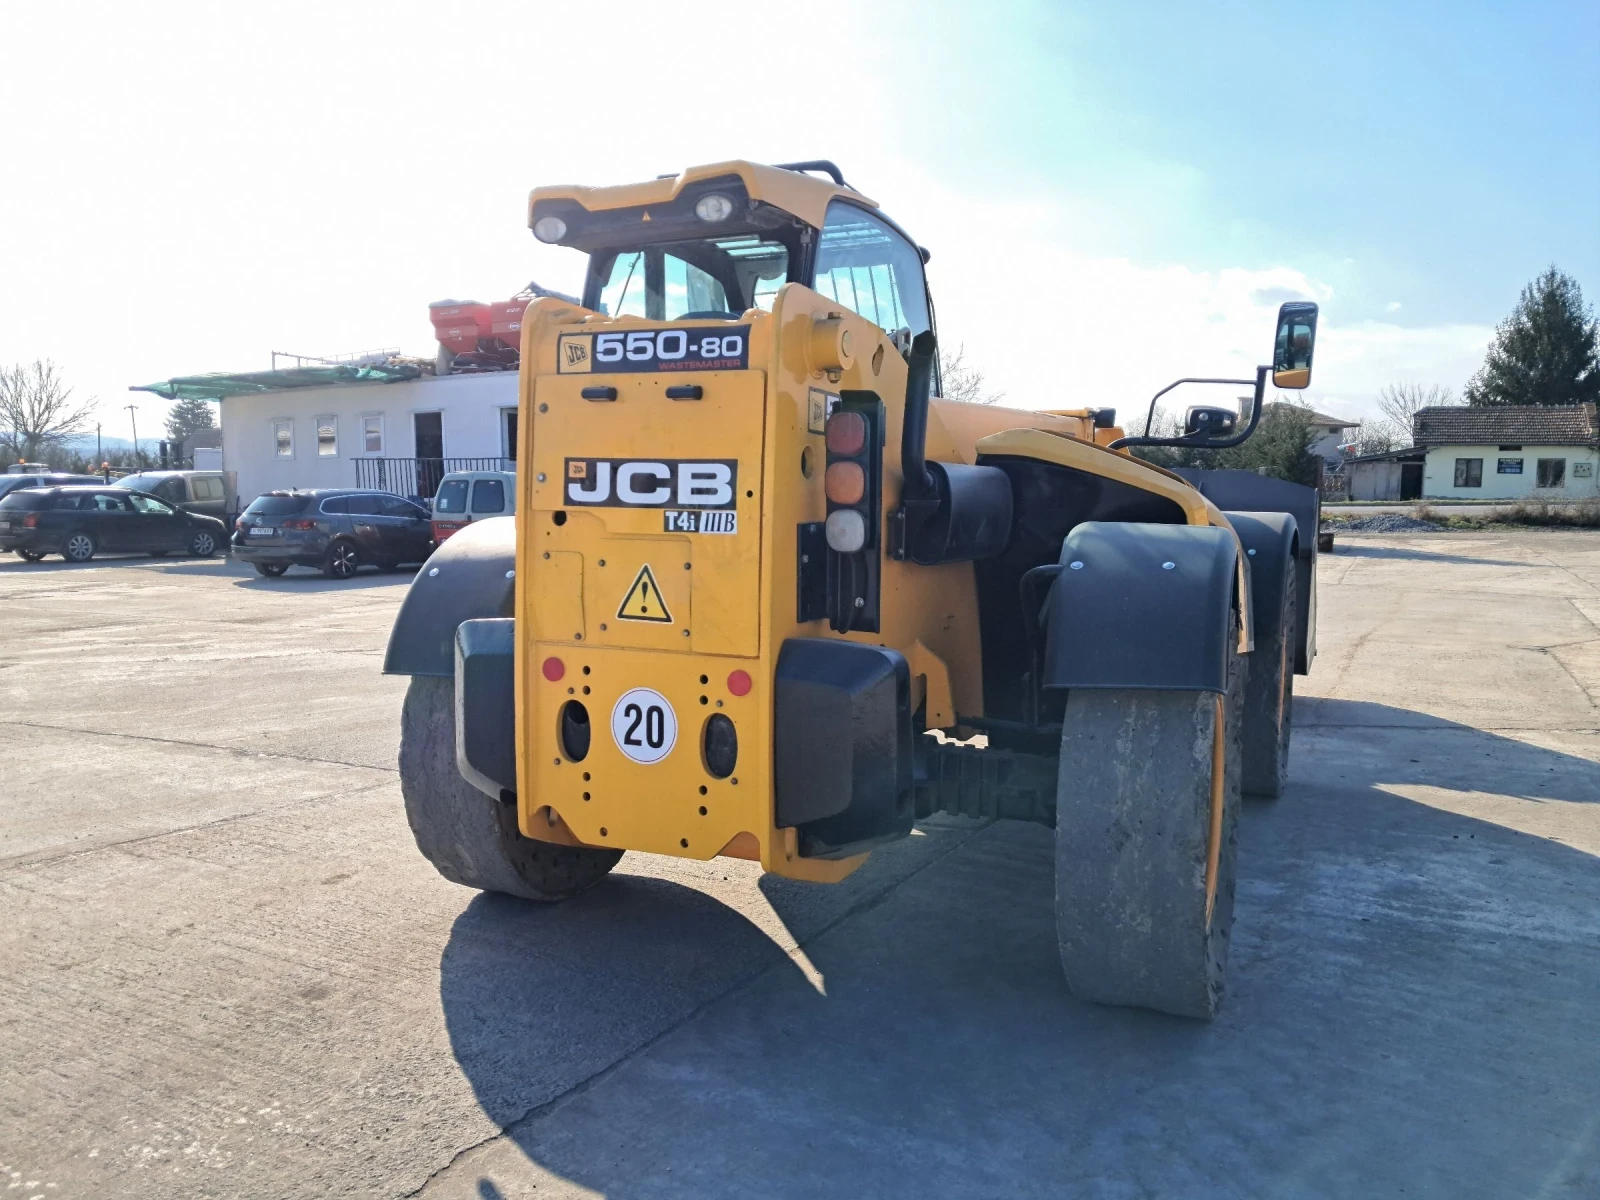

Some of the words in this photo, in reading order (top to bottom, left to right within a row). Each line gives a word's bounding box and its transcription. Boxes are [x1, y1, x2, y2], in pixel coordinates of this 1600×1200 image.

[568, 342, 587, 363] JCB
[596, 330, 743, 362] 550-80
[658, 359, 741, 370] WASTEMASTER
[568, 461, 733, 505] JCB
[665, 511, 696, 531] T4i
[624, 703, 664, 748] 20
